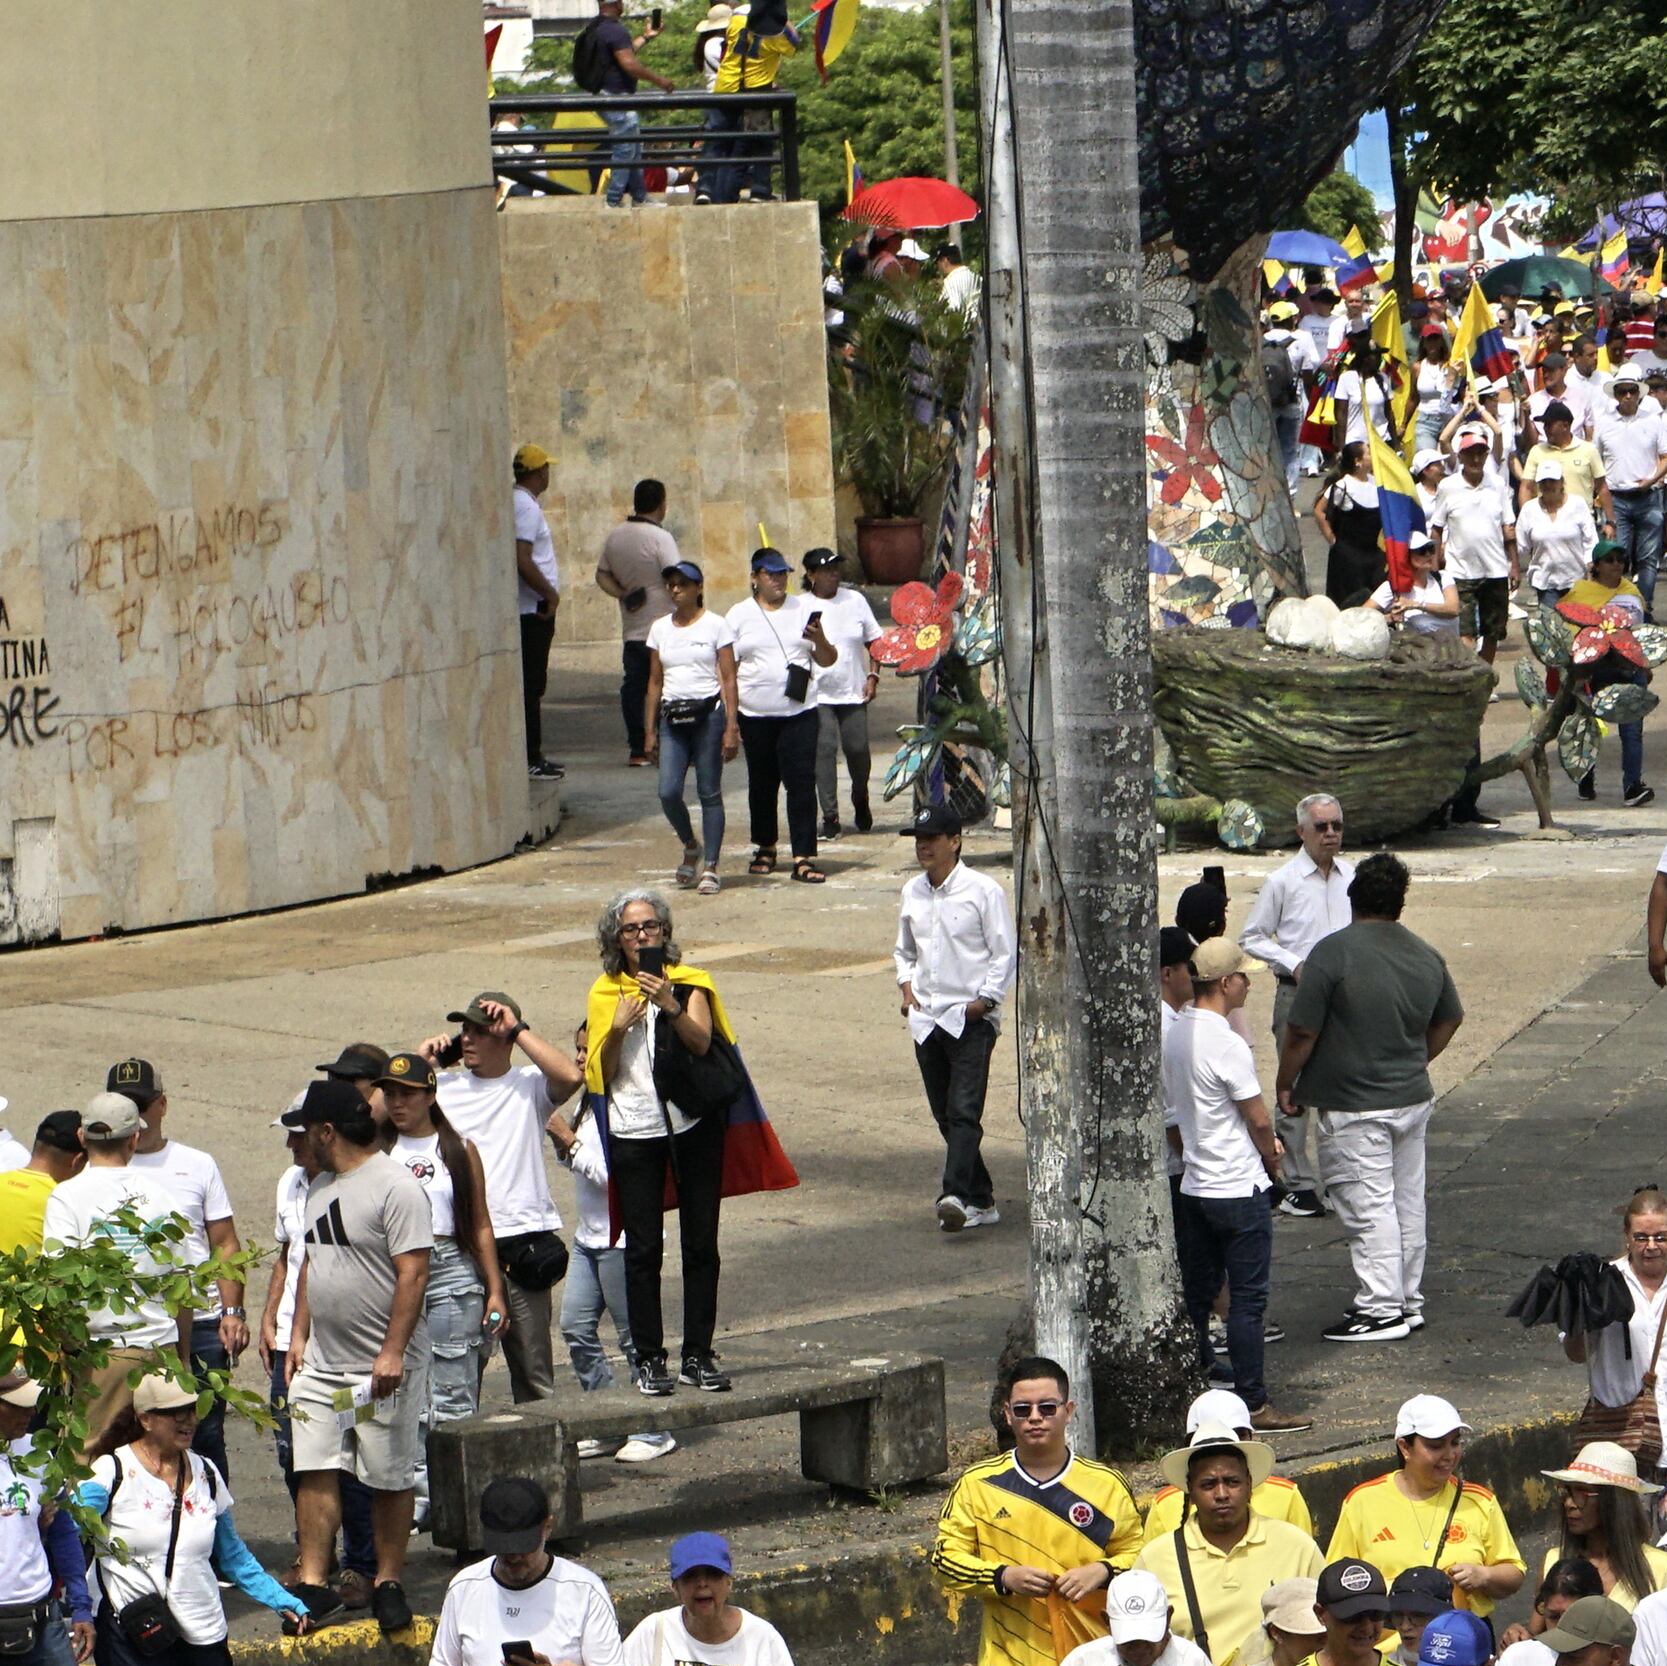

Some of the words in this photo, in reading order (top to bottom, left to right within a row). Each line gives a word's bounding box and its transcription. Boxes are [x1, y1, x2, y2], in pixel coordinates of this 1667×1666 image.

[66, 506, 282, 596] DETENGAMOS
[114, 597, 158, 664] EL
[174, 575, 352, 662] HOLOCAUSTO
[0, 637, 51, 680] TINA
[62, 716, 134, 785] POR
[154, 707, 219, 758] LOS
